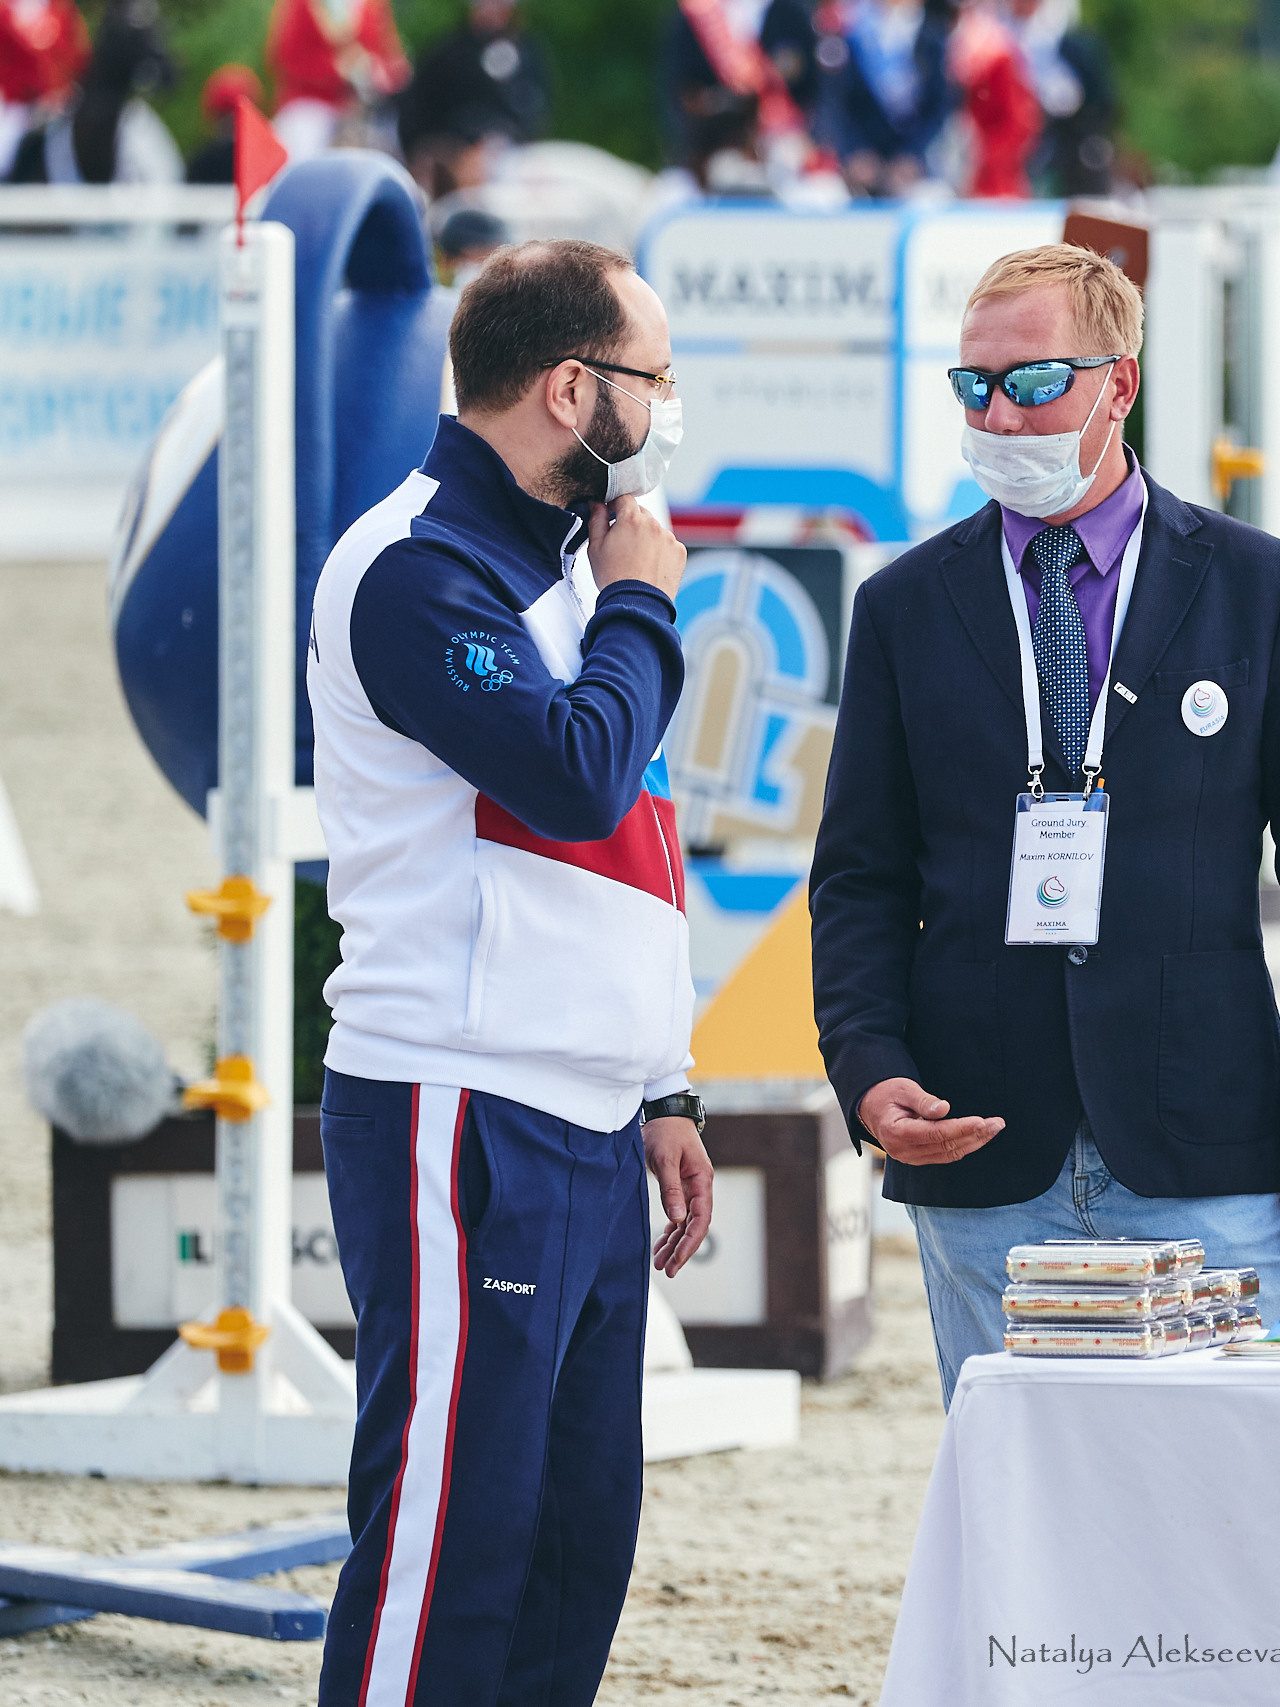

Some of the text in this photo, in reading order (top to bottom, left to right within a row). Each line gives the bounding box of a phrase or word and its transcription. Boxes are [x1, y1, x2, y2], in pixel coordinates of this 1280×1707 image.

[672, 258, 888, 318] MAXIM
[445, 631, 520, 692] RUSSIAN OLYMPIC TEAM
[1199, 714, 1225, 734] EURASIA
[1031, 818, 1087, 828] Ground Jury
[1039, 830, 1076, 839] Member
[1019, 852, 1095, 861] Maxim KORNILOV
[482, 1277, 537, 1296] ZASPORT
